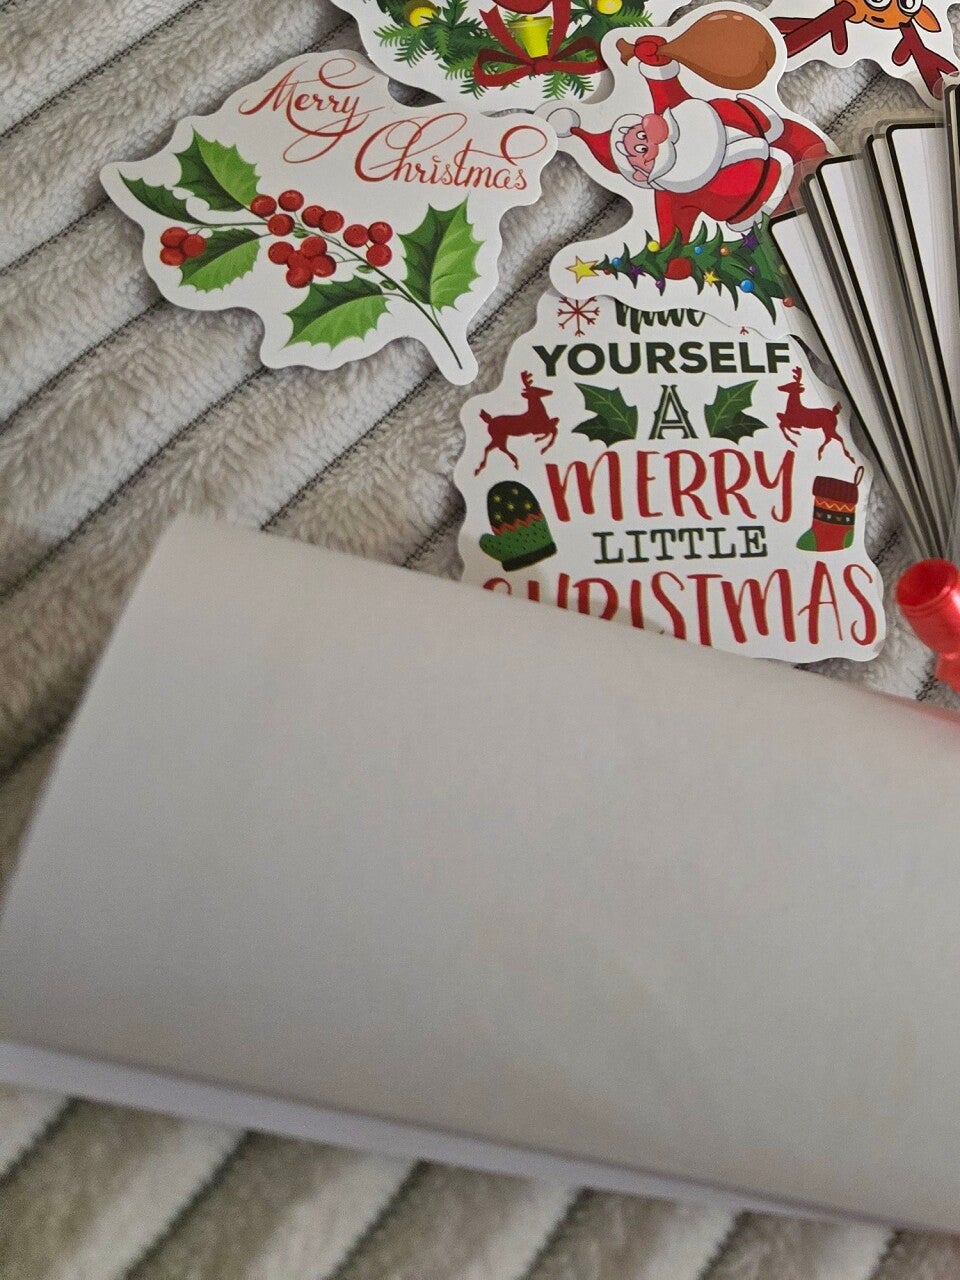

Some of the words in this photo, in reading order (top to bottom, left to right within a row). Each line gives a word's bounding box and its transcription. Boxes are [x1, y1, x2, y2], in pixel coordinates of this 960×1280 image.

[236, 58, 386, 164] Merry
[354, 112, 548, 192] Christmas
[532, 341, 790, 377] YOURSELF
[647, 384, 699, 440] A
[544, 449, 796, 523] MERRY
[593, 525, 768, 564] LITTLE
[482, 561, 877, 647] RISTMAS
